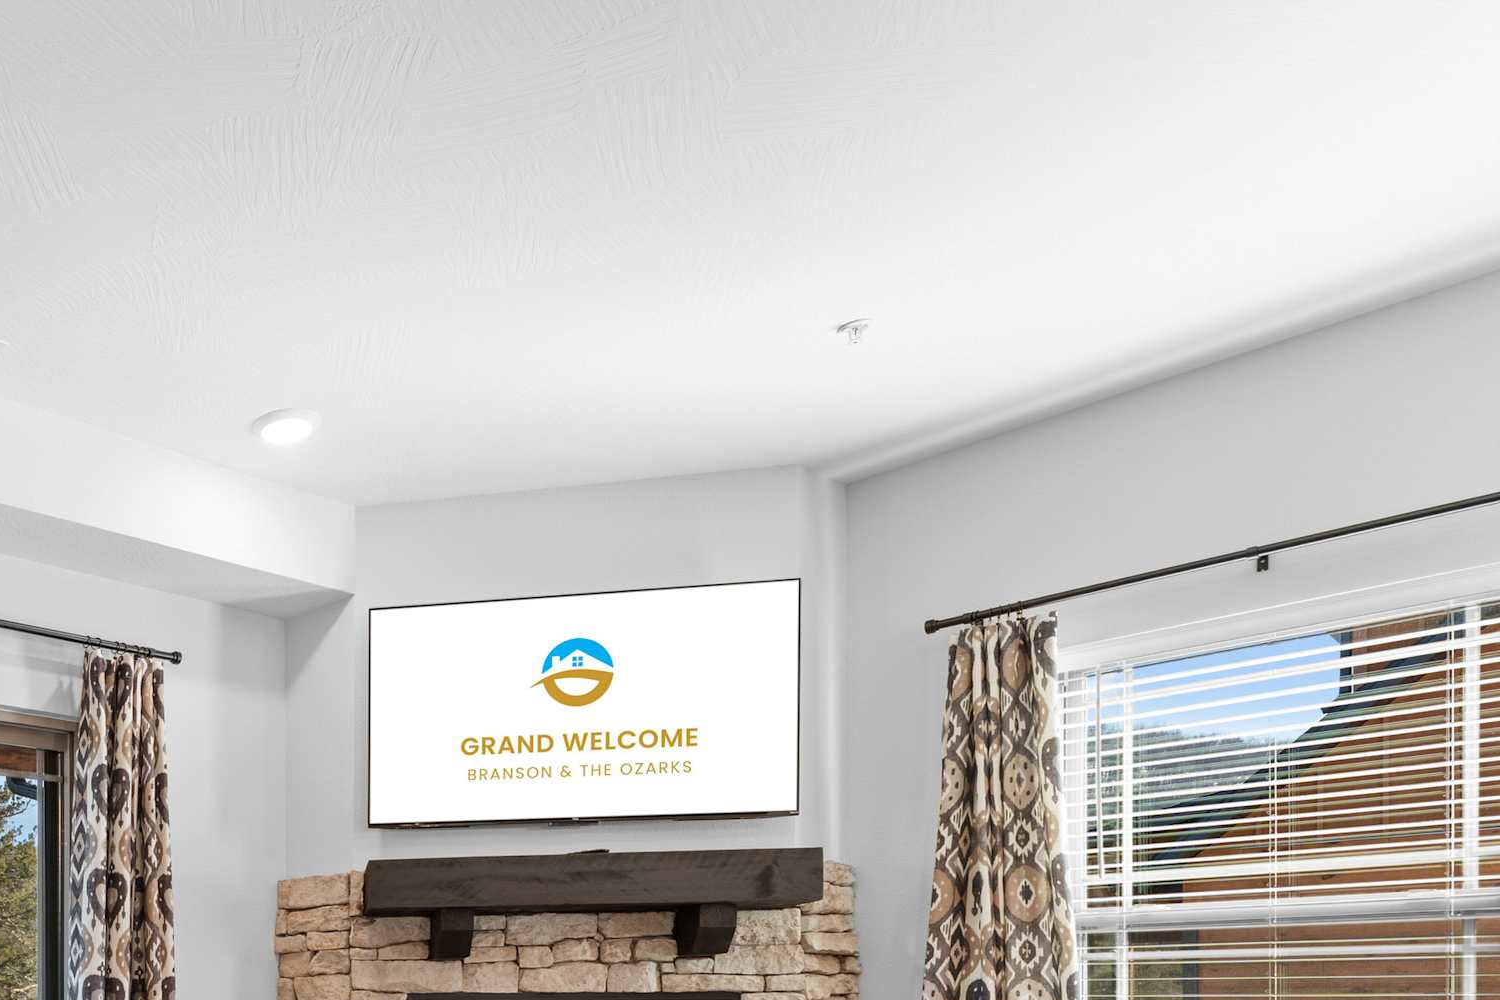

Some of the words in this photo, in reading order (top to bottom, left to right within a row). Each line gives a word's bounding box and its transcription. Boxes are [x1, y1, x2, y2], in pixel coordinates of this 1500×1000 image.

[460, 733, 554, 756] GRAND
[562, 727, 699, 752] WELCOME
[467, 766, 553, 782] BRANSON
[560, 765, 573, 778] &
[580, 763, 612, 777] THE
[620, 760, 693, 776] OZARKS
